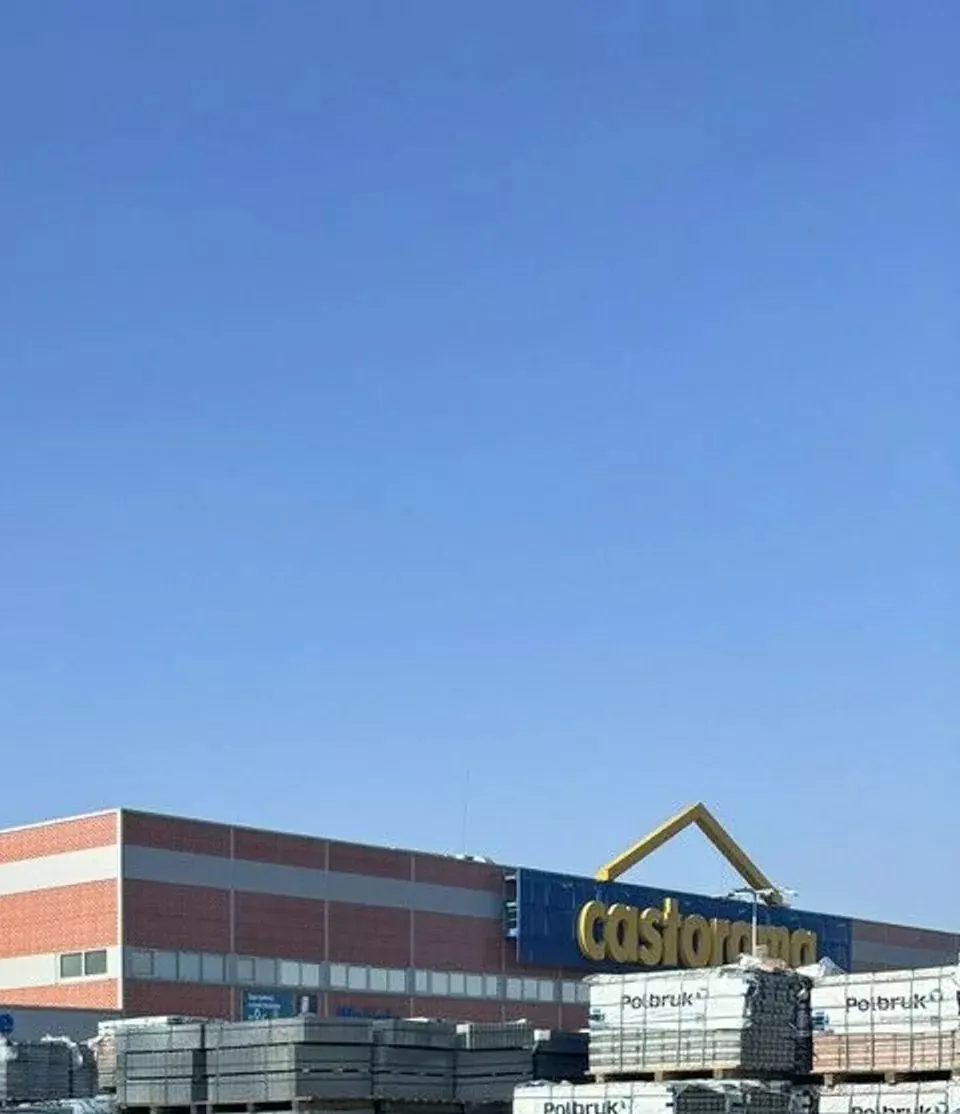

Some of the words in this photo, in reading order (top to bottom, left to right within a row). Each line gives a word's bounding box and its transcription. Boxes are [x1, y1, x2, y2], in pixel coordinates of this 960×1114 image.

[577, 898, 817, 966] castorama
[622, 992, 693, 1009] Polbruk
[847, 993, 927, 1012] Polbruk
